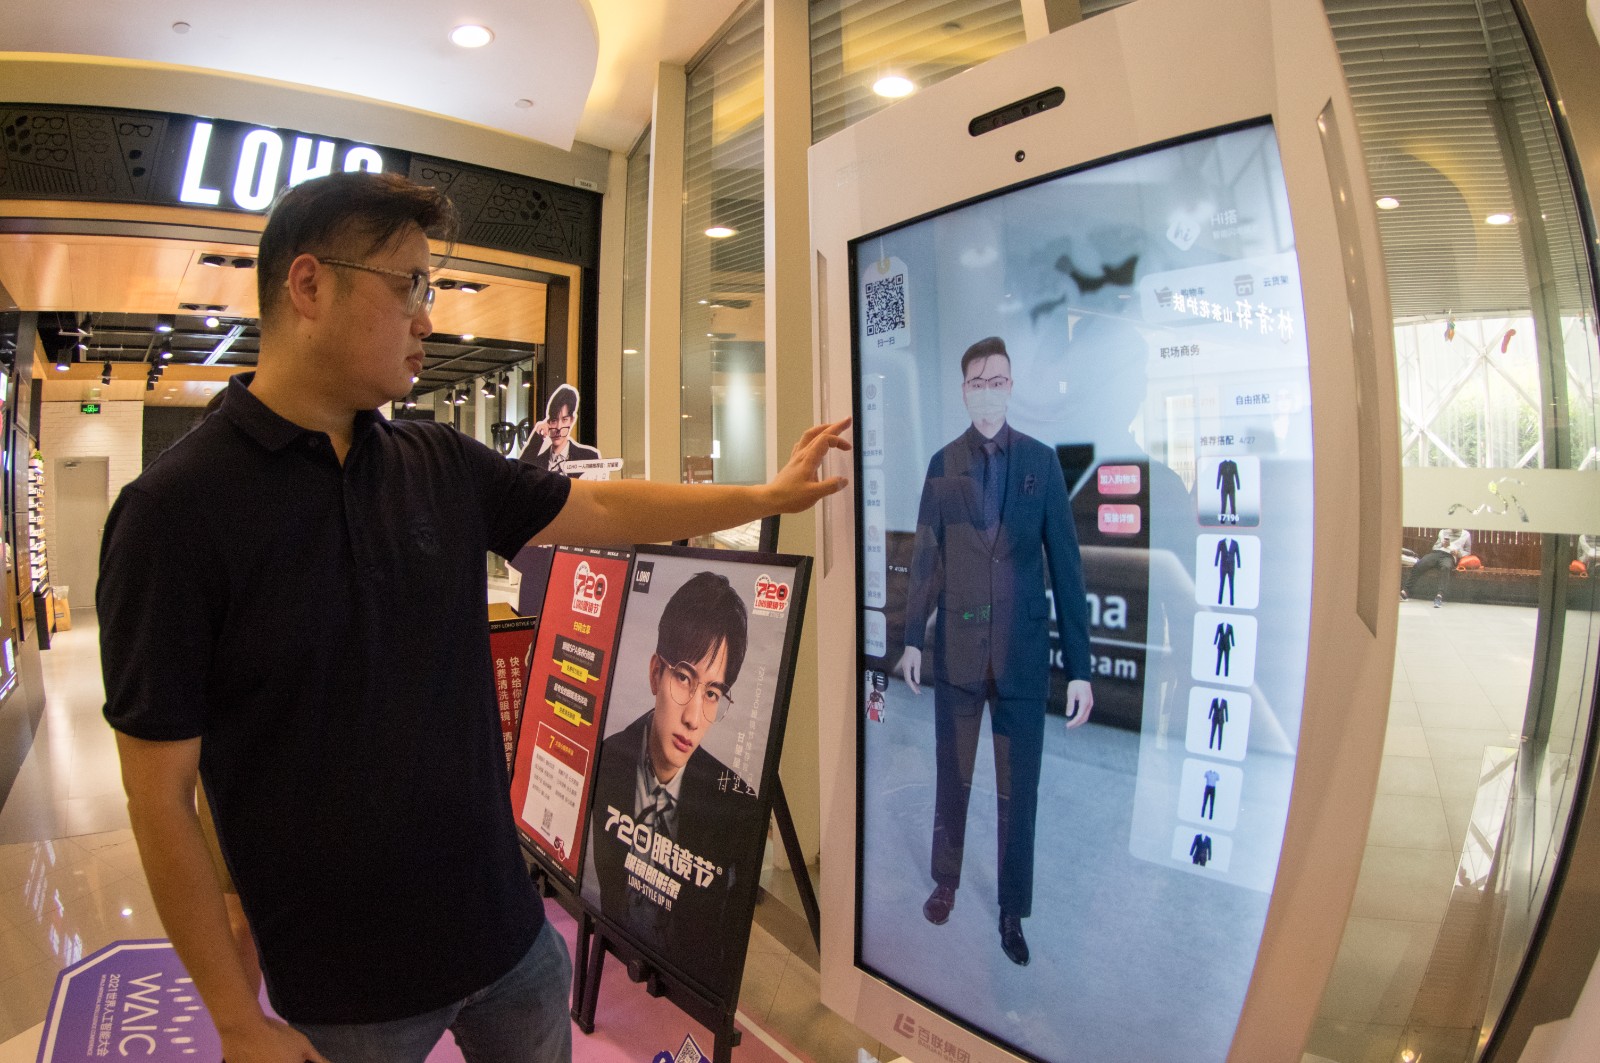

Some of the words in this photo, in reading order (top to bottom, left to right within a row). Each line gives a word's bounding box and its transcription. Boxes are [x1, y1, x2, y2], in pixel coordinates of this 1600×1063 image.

[1263, 275, 1289, 287] 云货架
[877, 337, 895, 348] 扫一扫
[1160, 344, 1200, 359] 职场商务
[1235, 394, 1271, 406] 自由搭配
[1200, 435, 1234, 446] 推荐搭配
[1100, 475, 1137, 485] 加入购物车
[1104, 513, 1134, 524] 服装详情
[576, 573, 606, 601] 720
[757, 582, 787, 601] 720
[97, 973, 121, 1057] 2021世界人工智能大会
[118, 972, 163, 1057] WAIC
[918, 1025, 971, 1063] 百联集团
